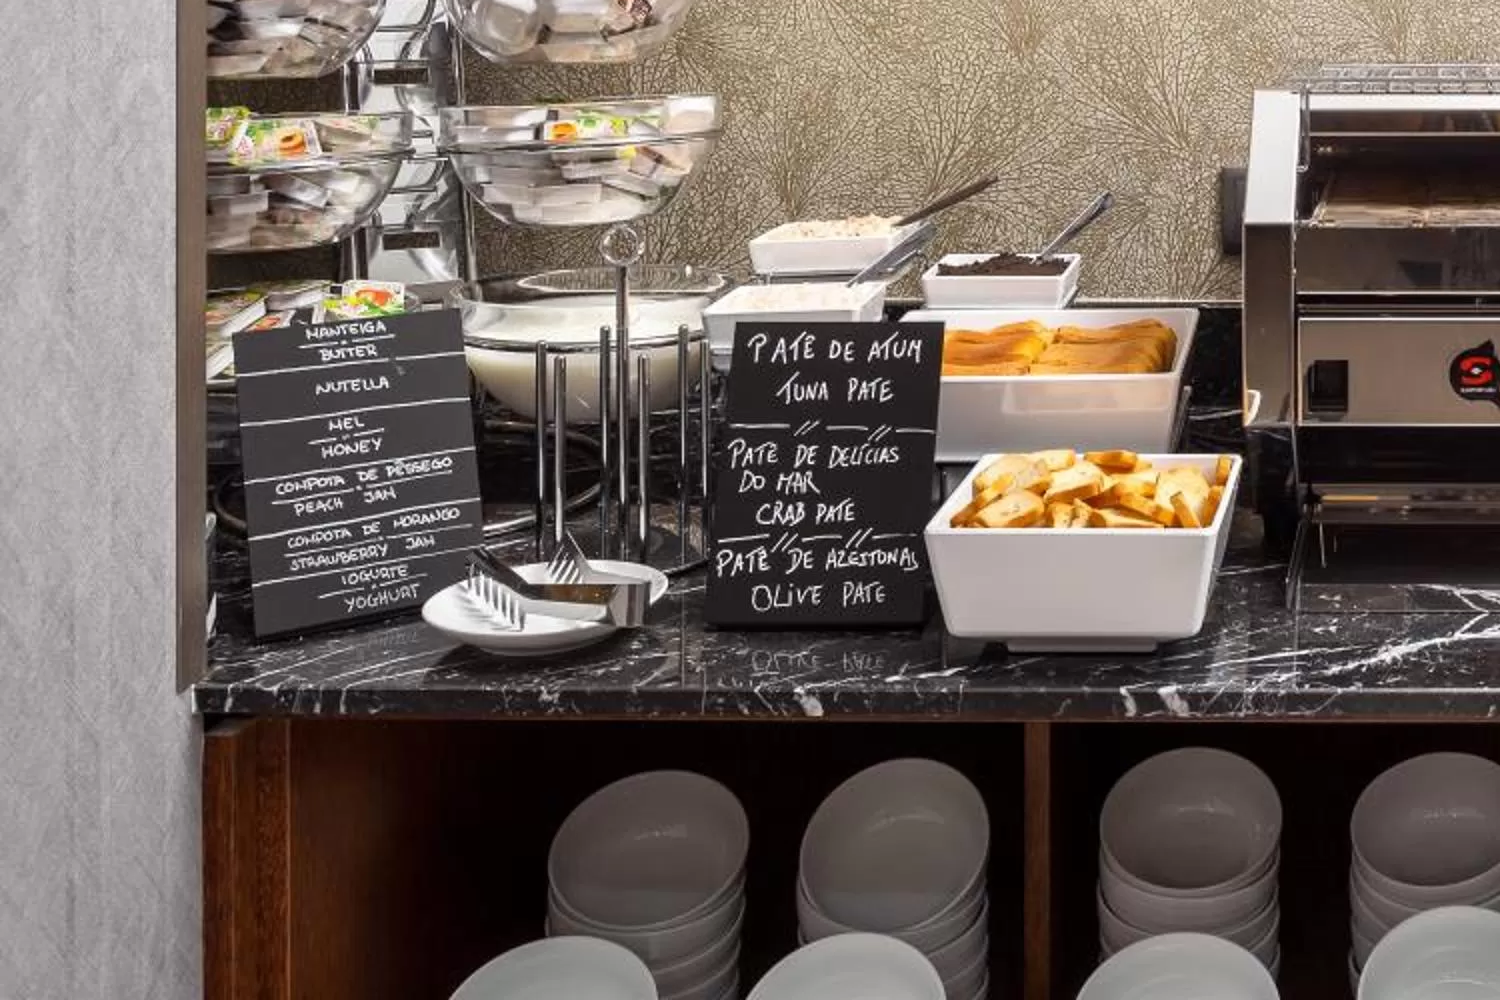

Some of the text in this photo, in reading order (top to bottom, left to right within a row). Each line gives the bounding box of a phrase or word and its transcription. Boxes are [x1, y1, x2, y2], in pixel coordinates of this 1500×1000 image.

[305, 320, 388, 341] MANTEIGA
[319, 345, 378, 362] BUTTER
[829, 340, 855, 362] DE
[867, 332, 922, 364] ATUM
[315, 376, 390, 396] NUTELLA
[775, 371, 894, 405] TUNA PATE
[328, 417, 365, 432] MEL
[321, 438, 382, 459] HONEY
[794, 444, 821, 469] DE
[275, 475, 346, 496] COMPOTA
[356, 468, 379, 483] DE
[738, 470, 821, 495] DO MAR
[293, 486, 397, 516] PEACH JAM
[755, 497, 856, 527] CRAB PATE
[287, 508, 461, 548] COMPOTA DE MORANGO
[289, 535, 436, 571] STRAWBERRY JAM
[785, 548, 815, 575] DE
[341, 565, 409, 585] IOGURTE
[343, 583, 421, 613] YOGHURT
[751, 581, 887, 612] OLIVE PATE
